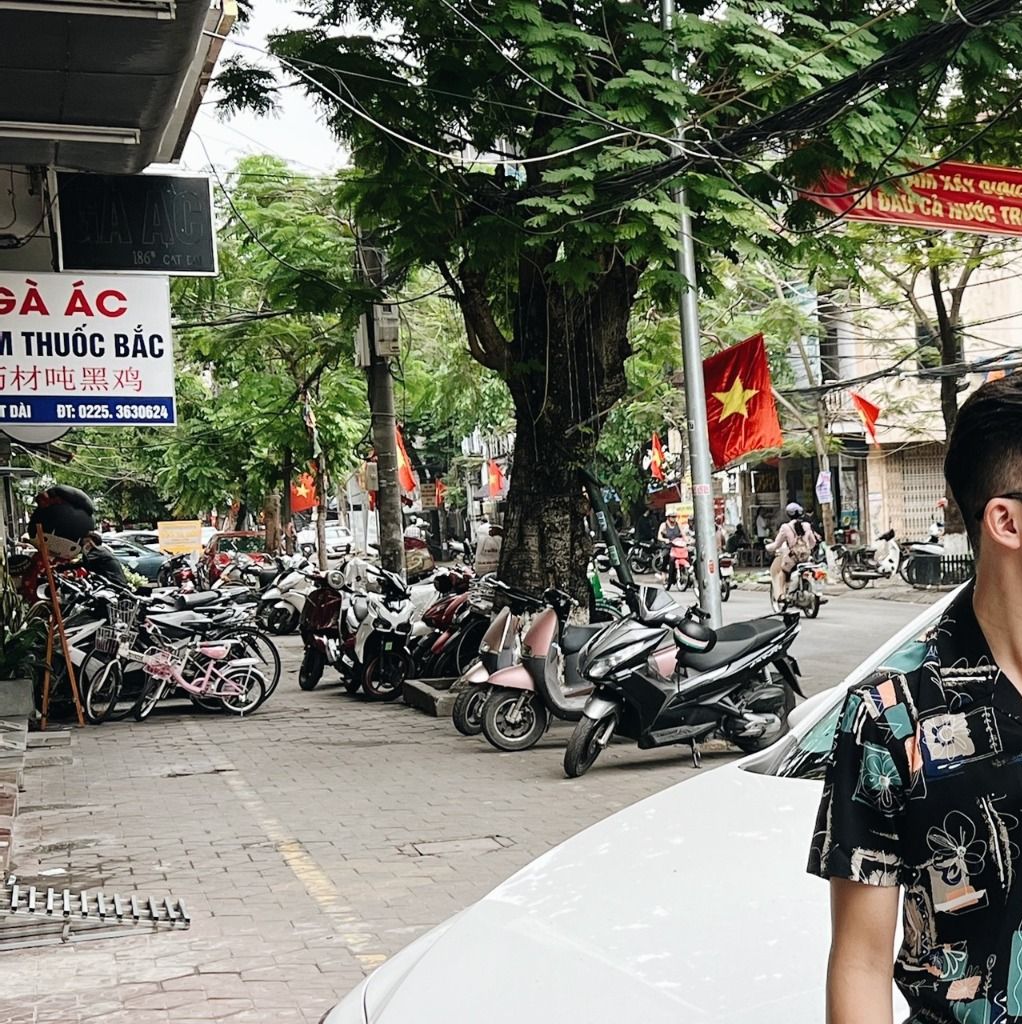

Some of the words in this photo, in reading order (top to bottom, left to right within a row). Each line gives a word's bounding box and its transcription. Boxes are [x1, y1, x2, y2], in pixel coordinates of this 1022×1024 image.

[947, 200, 997, 223] NƯỚC
[64, 280, 128, 318] ÁC
[21, 324, 105, 357] THUỐC
[114, 324, 164, 358] BẮC
[10, 402, 31, 418] DÀI
[78, 404, 113, 419] 0225.
[116, 404, 168, 419] 3630624
